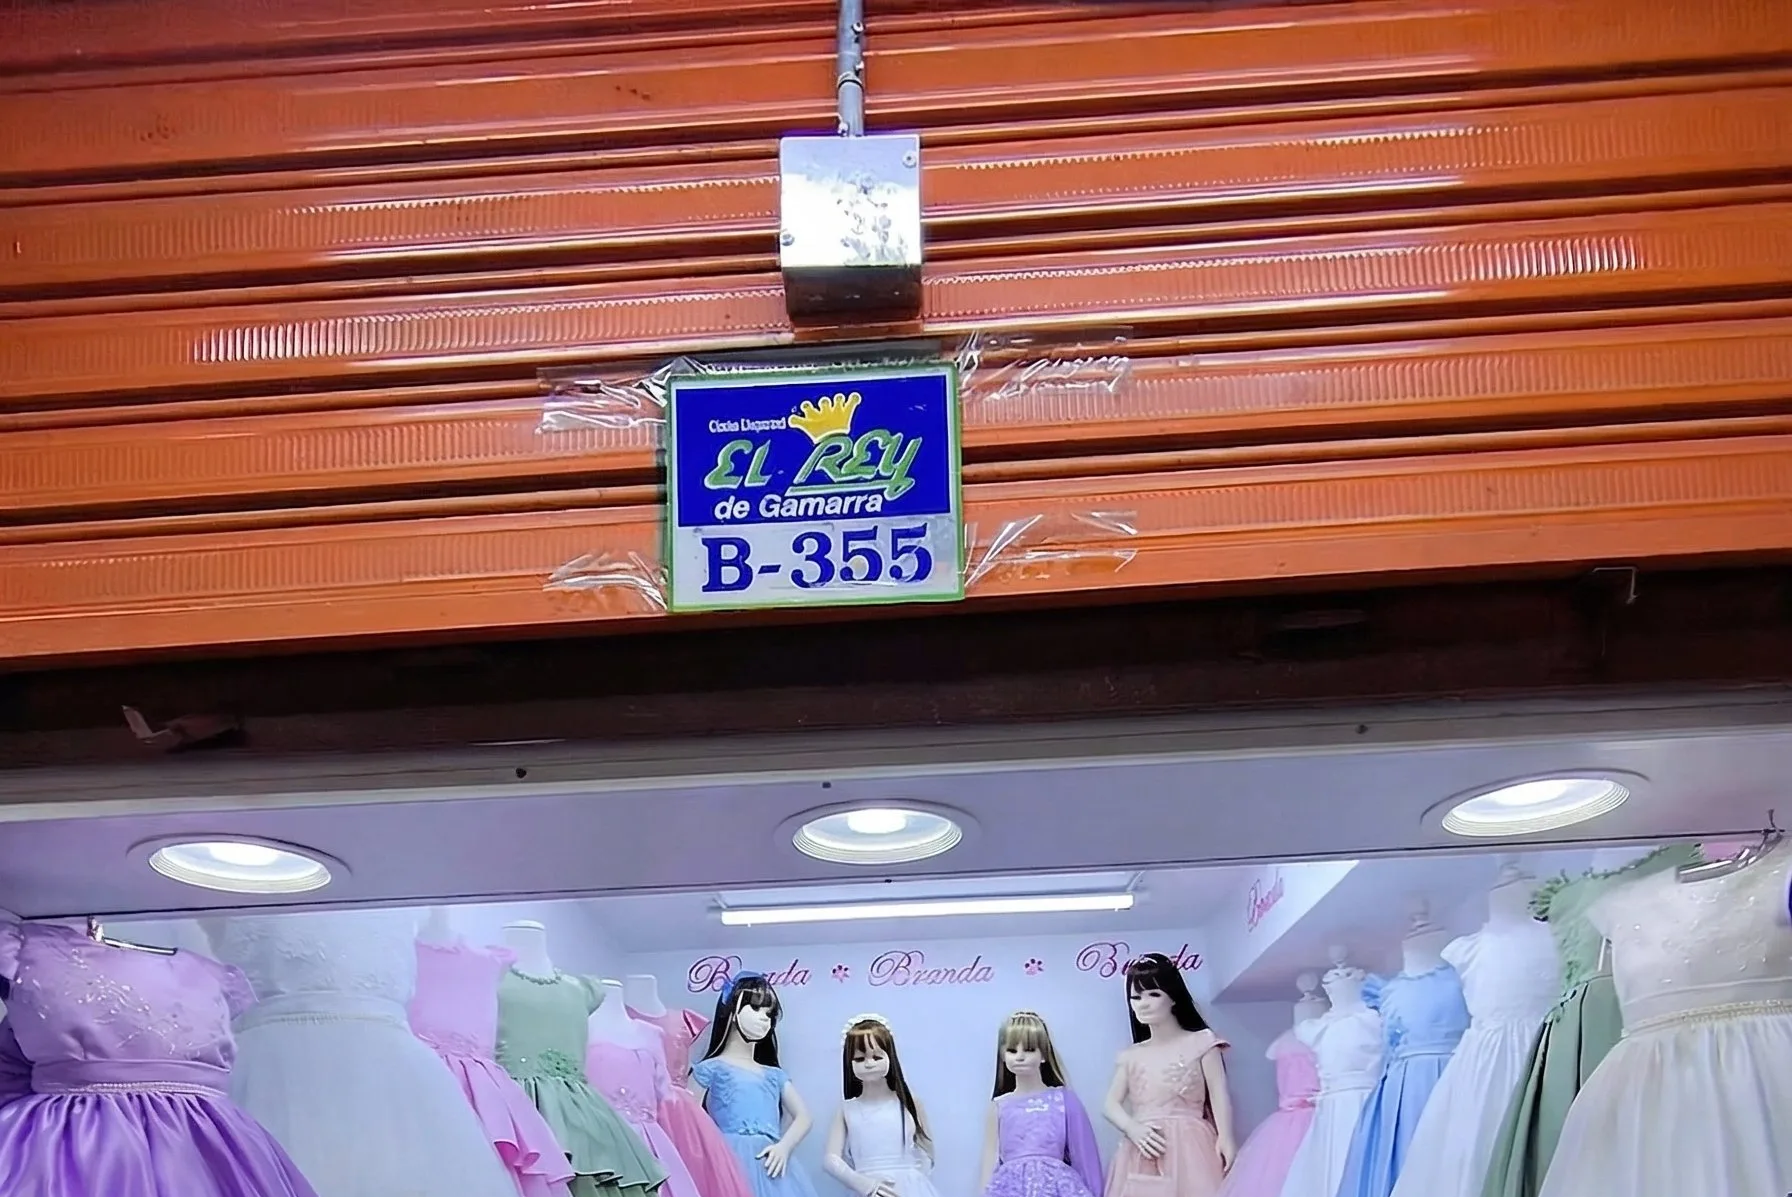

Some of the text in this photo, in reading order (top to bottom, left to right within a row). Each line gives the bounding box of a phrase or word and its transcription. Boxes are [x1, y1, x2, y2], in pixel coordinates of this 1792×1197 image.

[704, 439, 772, 489] EL
[714, 492, 883, 520] de Gamarra
[701, 524, 932, 593] B-355
[1076, 941, 1203, 978] Brda
